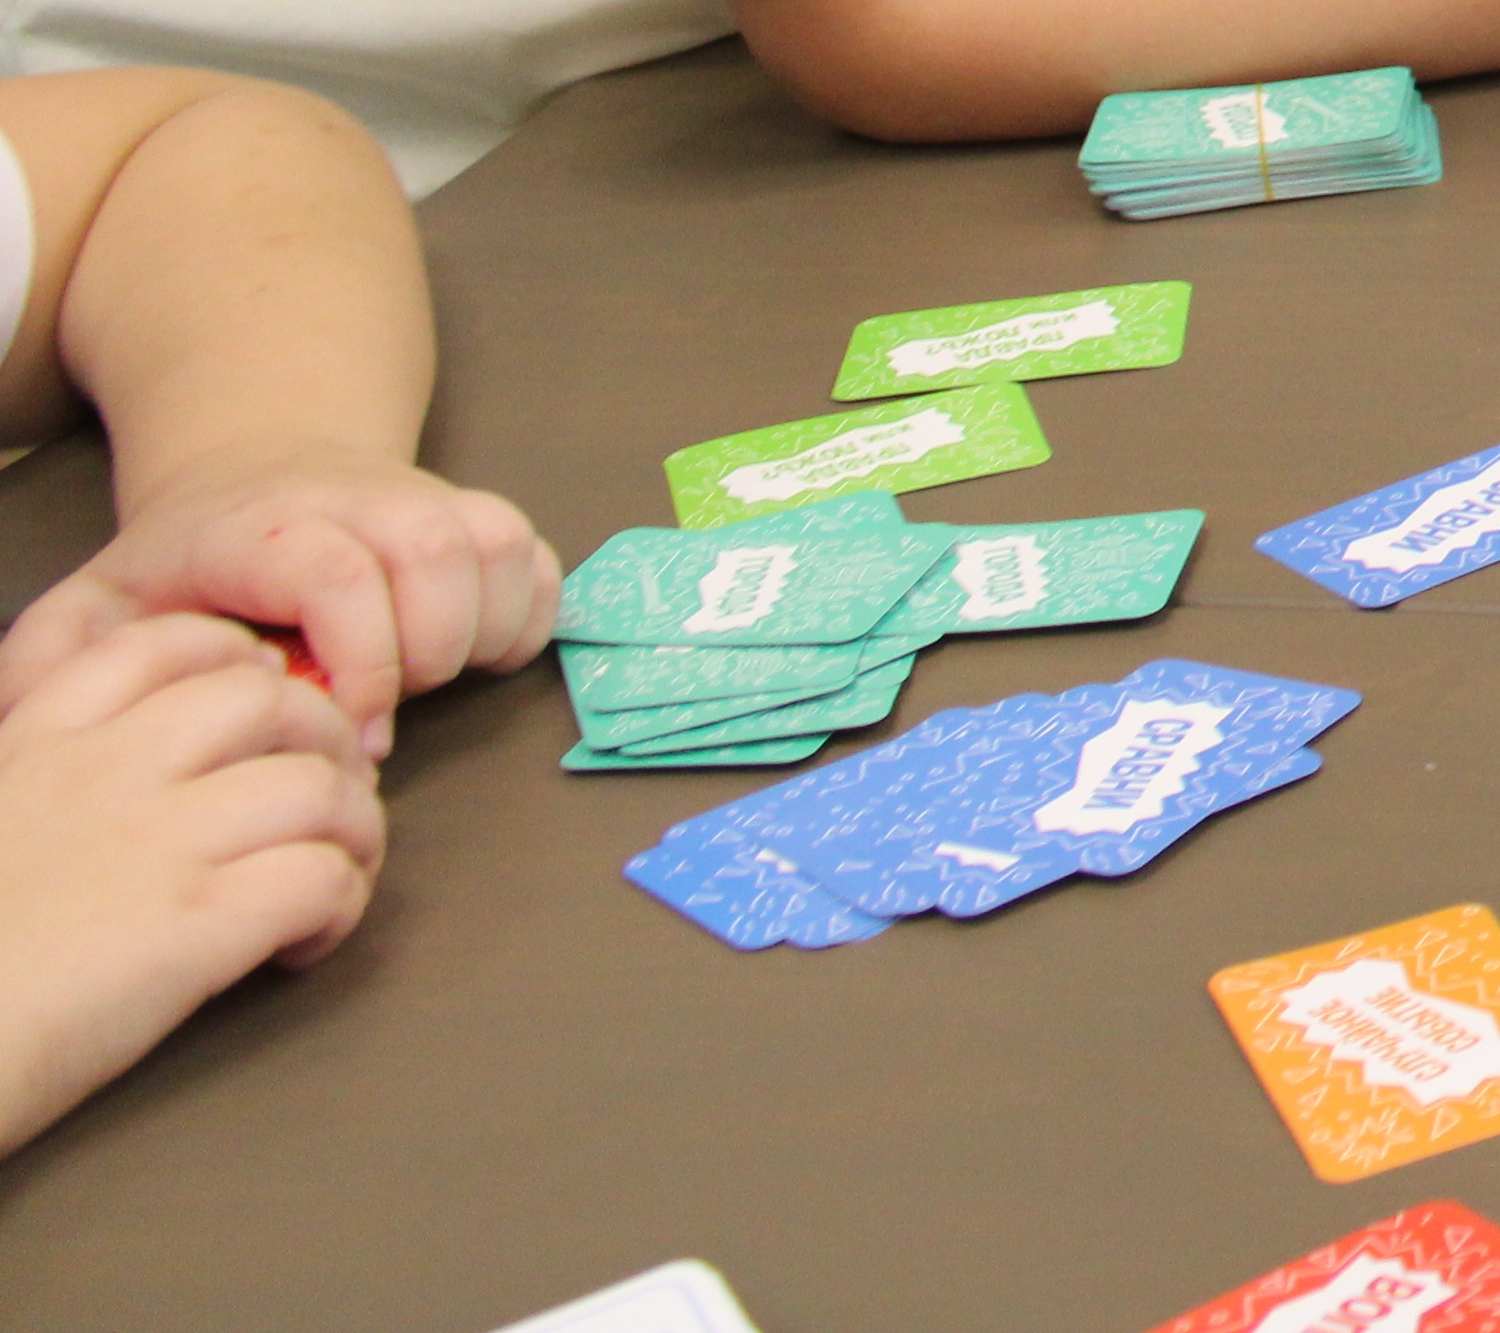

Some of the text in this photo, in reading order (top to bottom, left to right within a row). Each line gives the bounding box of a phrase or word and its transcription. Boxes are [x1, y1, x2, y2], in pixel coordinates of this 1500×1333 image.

[955, 331, 1065, 362] ПРАВДА
[797, 443, 911, 483] ПРАВДА
[714, 554, 778, 619] ГОРОДА
[982, 545, 1028, 608] ГОРОДА
[1081, 718, 1195, 810] СРАВНИ
[1307, 998, 1450, 1081] СЛУЧАЙНОЕ
[1364, 985, 1482, 1053] СОБЫТИЕ
